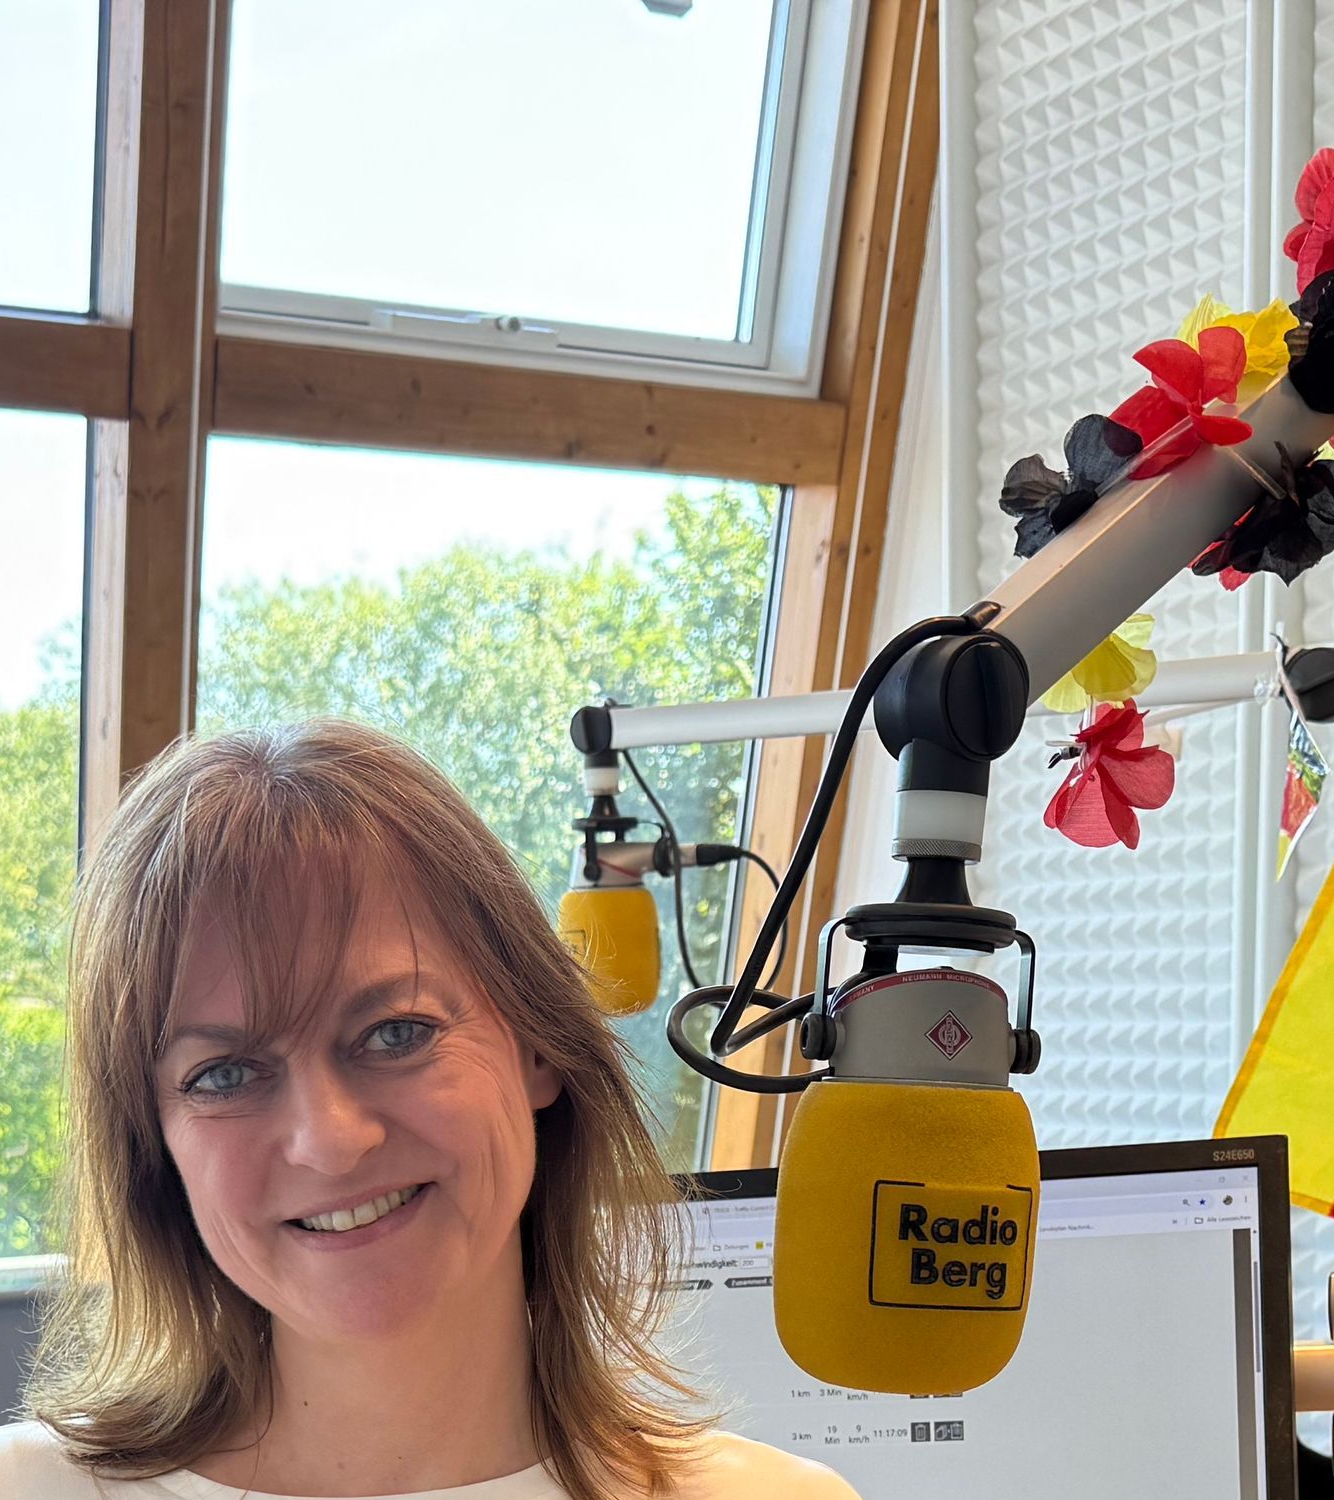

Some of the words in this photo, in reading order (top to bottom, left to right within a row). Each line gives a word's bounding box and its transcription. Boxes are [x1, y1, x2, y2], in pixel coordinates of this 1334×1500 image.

[1213, 1149, 1254, 1161] S24E650
[899, 1204, 1017, 1245] Radio
[911, 1248, 1007, 1300] Berg
[797, 1390, 811, 1398] km
[825, 1388, 842, 1397] Min
[828, 1426, 837, 1434] 19
[856, 1425, 862, 1433] 9
[799, 1432, 812, 1441] km
[825, 1436, 840, 1445] Min
[849, 1436, 870, 1445] km/h
